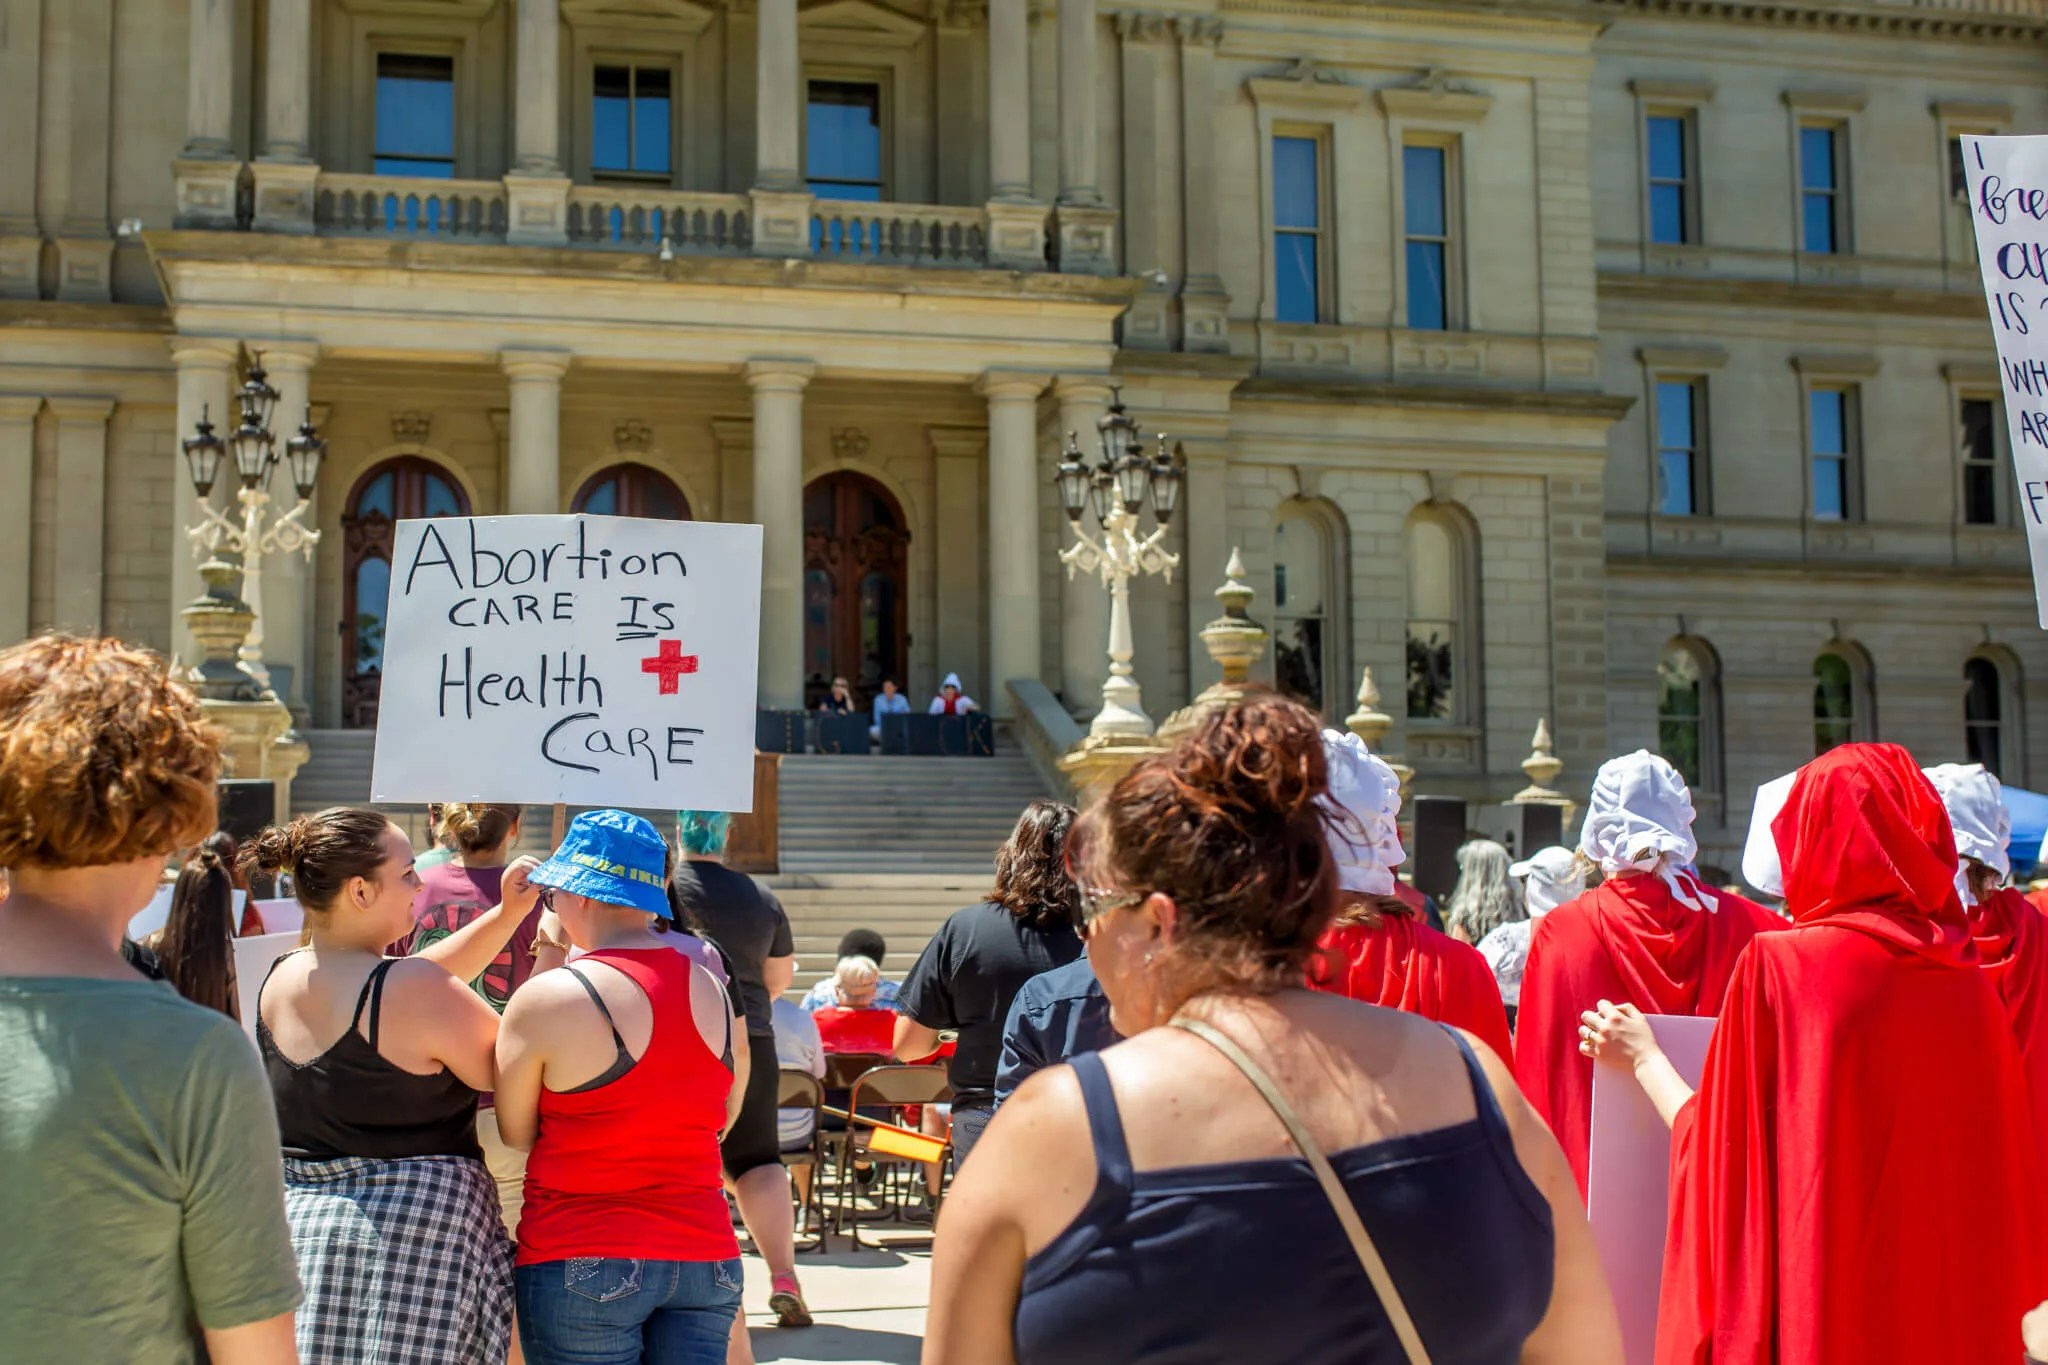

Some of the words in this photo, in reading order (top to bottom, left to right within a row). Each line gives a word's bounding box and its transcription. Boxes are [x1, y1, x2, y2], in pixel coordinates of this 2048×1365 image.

[1978, 175, 2048, 225] bre
[1995, 292, 2028, 335] IS
[405, 518, 688, 595] Abortion
[448, 592, 575, 627] CARE
[616, 597, 675, 632] IS
[439, 646, 604, 719] Health
